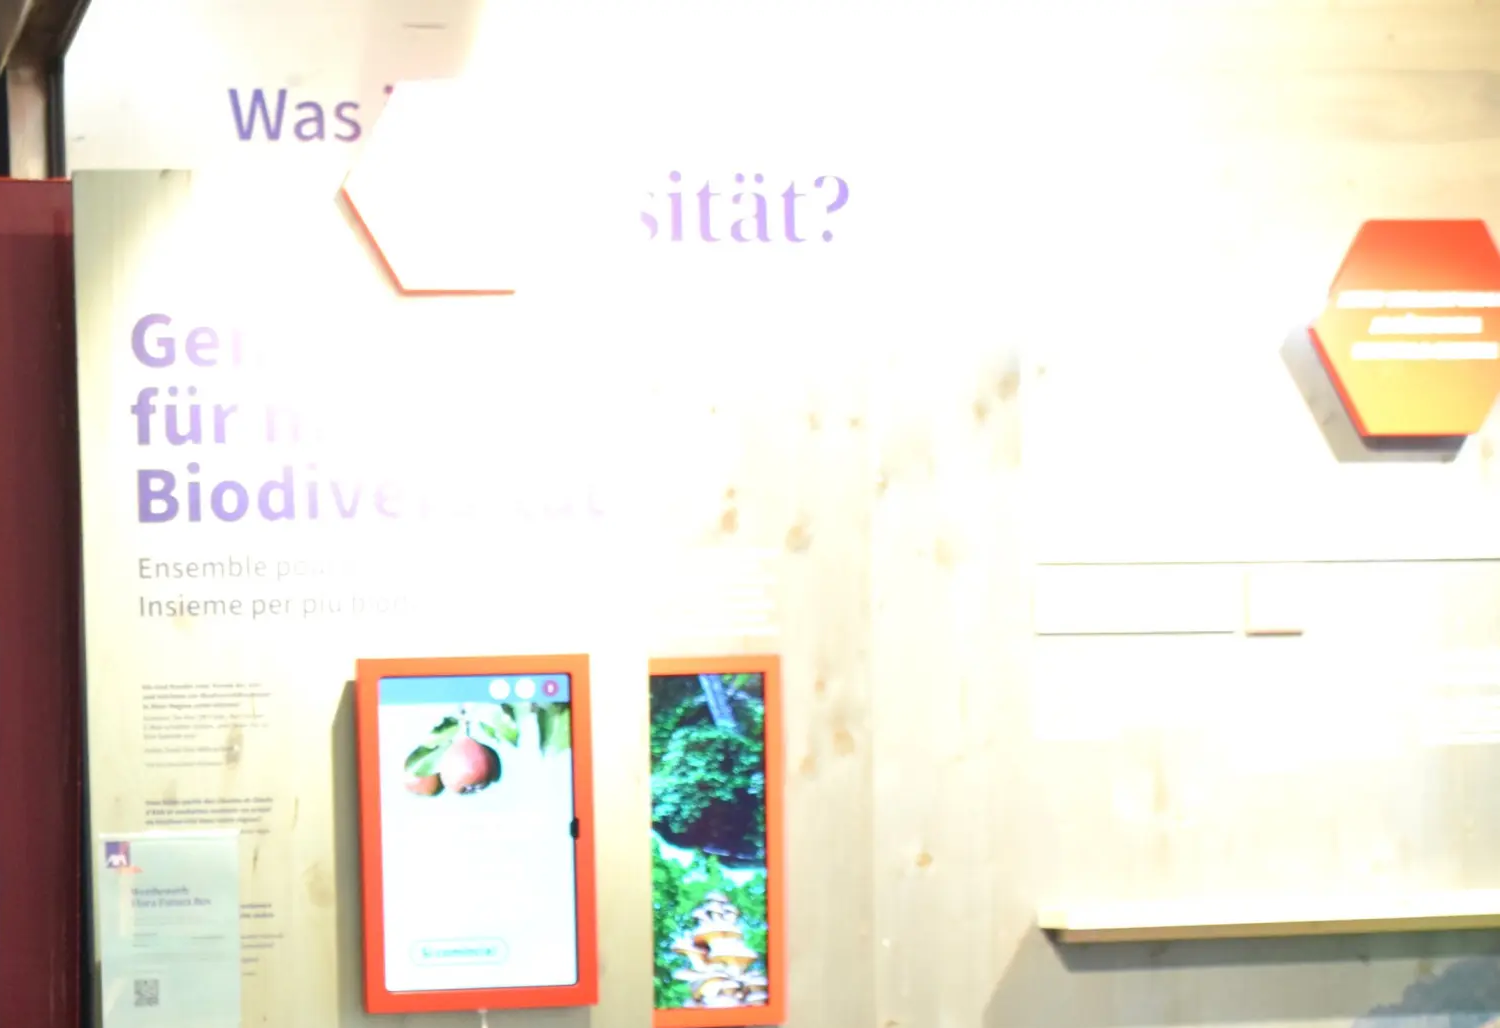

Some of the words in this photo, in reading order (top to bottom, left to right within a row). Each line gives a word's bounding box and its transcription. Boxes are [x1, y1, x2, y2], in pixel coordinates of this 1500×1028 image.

[227, 87, 362, 142] Was
[130, 385, 238, 445] für
[138, 555, 268, 579] Ensemble
[139, 594, 242, 617] Insieme
[252, 598, 292, 620] per
